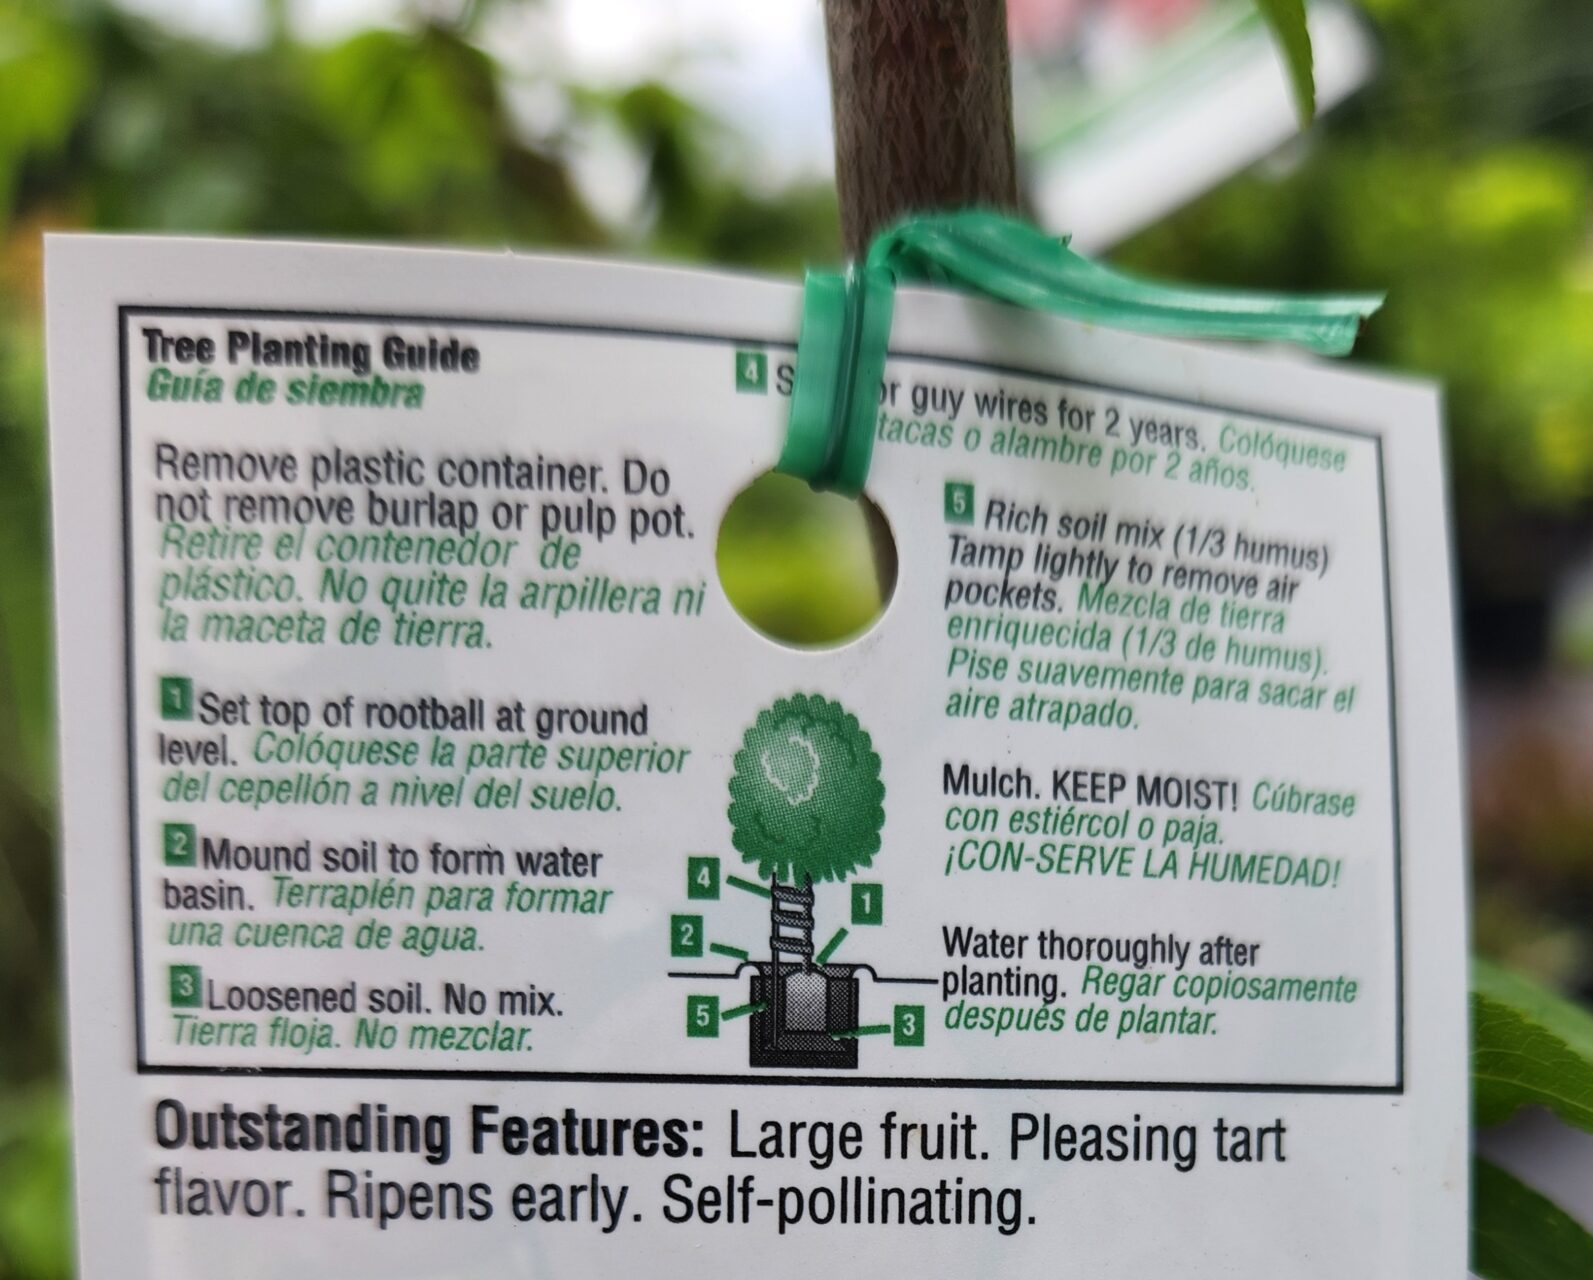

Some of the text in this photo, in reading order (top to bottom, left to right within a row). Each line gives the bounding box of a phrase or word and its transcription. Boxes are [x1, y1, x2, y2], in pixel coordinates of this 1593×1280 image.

[143, 328, 480, 376] Tree Planting Guide
[147, 367, 425, 410] Guía de siembra
[743, 360, 759, 384] 4
[911, 381, 964, 417] guy
[974, 387, 1046, 426] wires
[1057, 399, 1094, 432] for
[1105, 410, 1121, 437] 2
[1130, 416, 1206, 453] years.
[1219, 423, 1348, 473] Colóquese
[155, 444, 670, 495] Remove plastic container. Do
[156, 490, 694, 542] not remove burlap or pulp pot.
[952, 491, 1329, 578] 5 Rich soil mix (1/3 humus)
[947, 617, 1328, 680] enriquecida (1/3 de humus).
[170, 688, 647, 741] 1 Set top of rootball at ground
[943, 763, 1354, 817] Mulch. KEEP MOIST! Cúbrase
[174, 834, 603, 878] 2 Mound soil to form water
[697, 867, 710, 887] 4
[944, 840, 1342, 888] ¡CON-SERVE LA HUMEDAD!
[862, 893, 871, 914] 1
[681, 924, 693, 945] 2
[943, 926, 1260, 970] Water thoroughly after
[180, 974, 563, 1017] 3 Loosened soil. No mix.
[943, 965, 1358, 1005] planting. Regar copiosamente
[173, 1015, 532, 1055] Tierra floja. No mezclar.
[697, 1005, 709, 1026] 5
[903, 1014, 915, 1035] 3
[154, 1096, 1285, 1172] Outstanding Features: Large fruit. Pleasing tart
[154, 1166, 1037, 1234] flavor. Ripens early. Self-pollinating.
